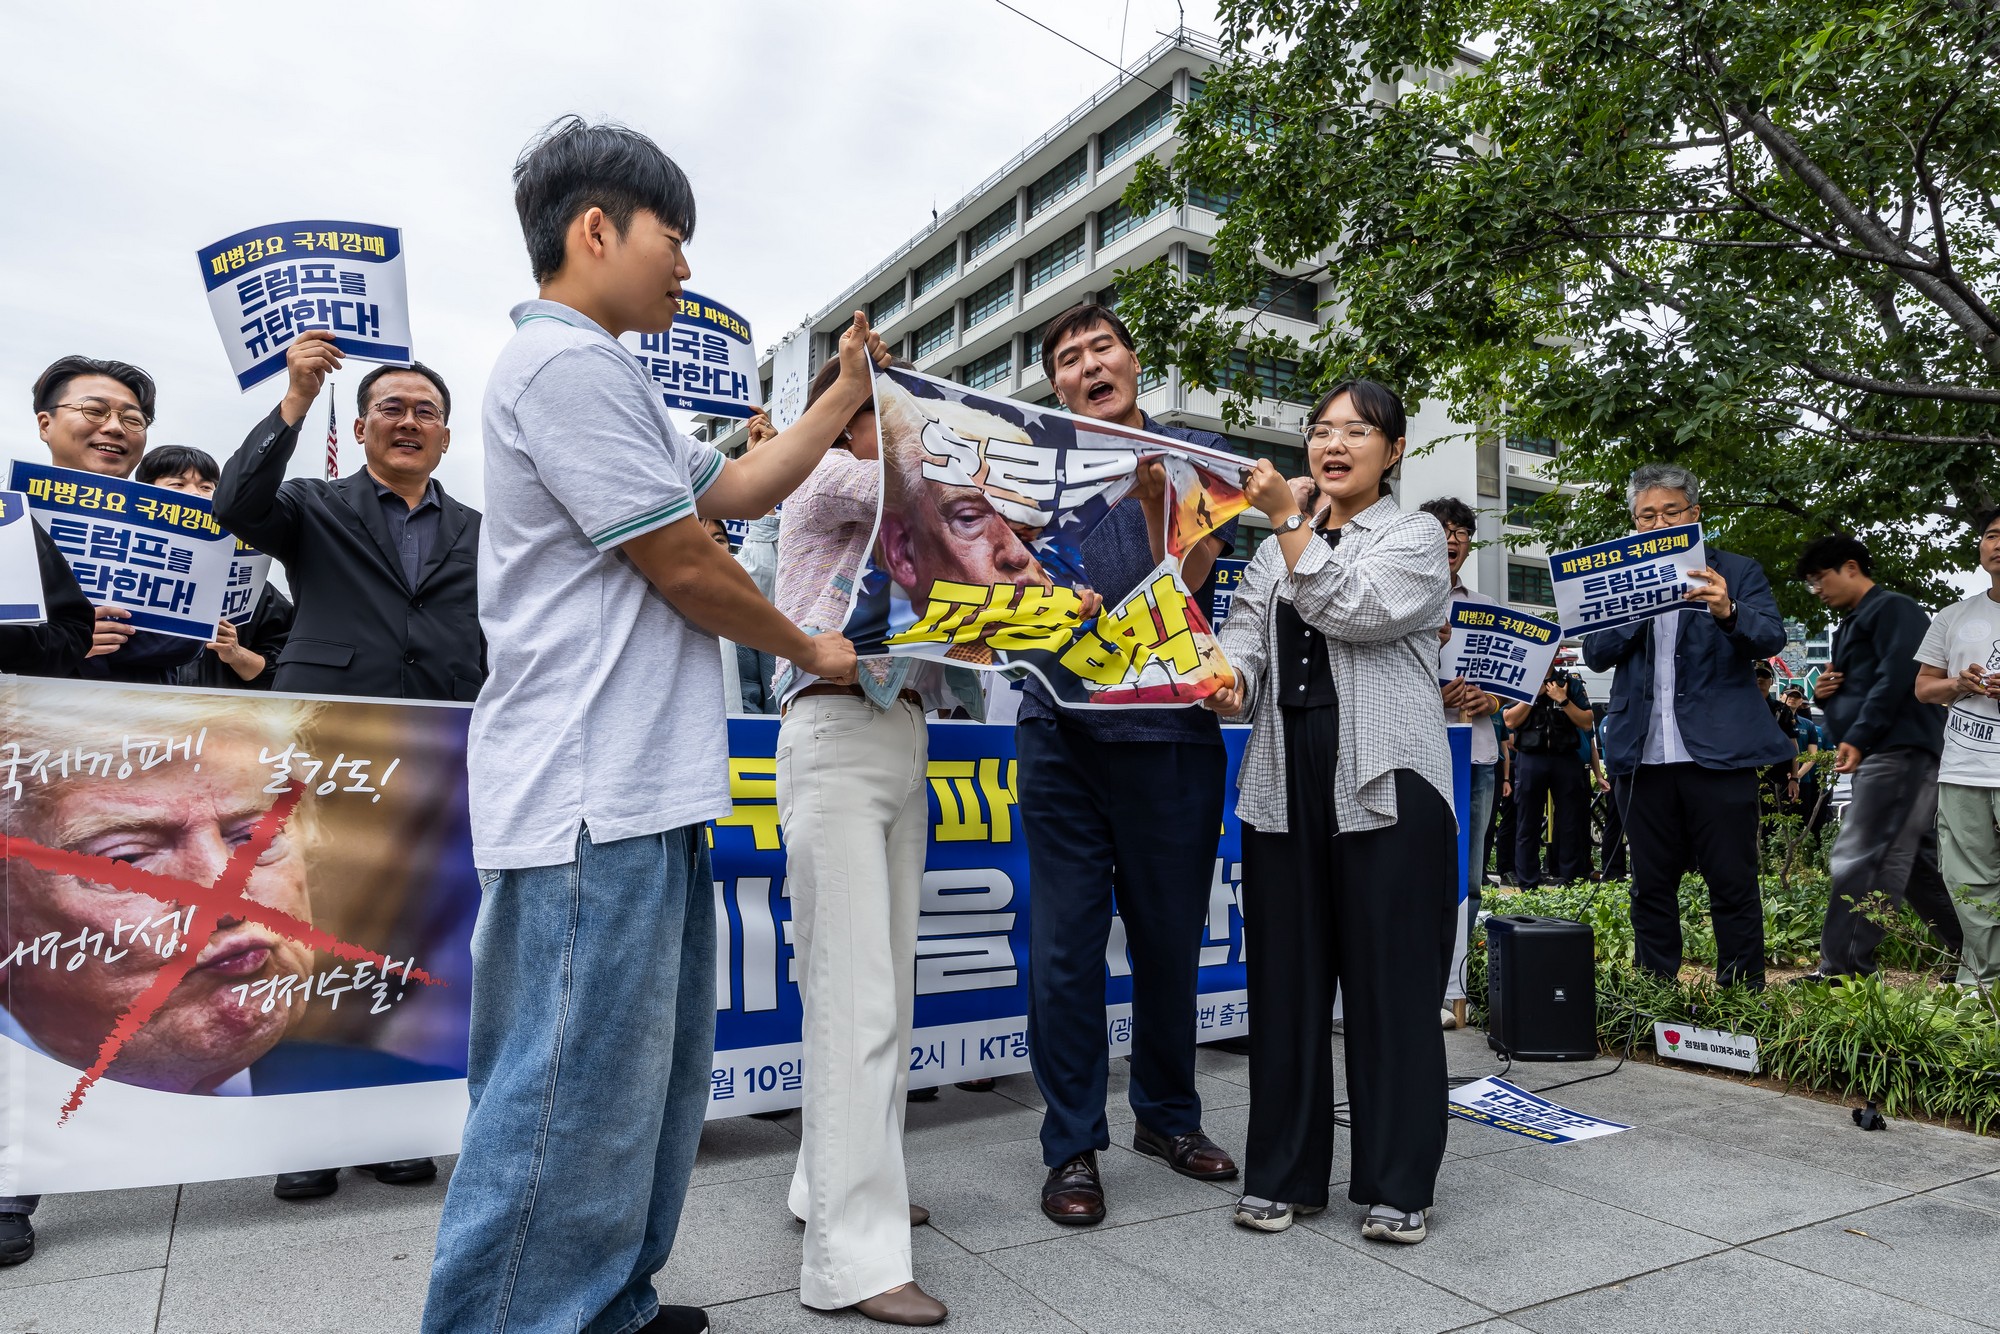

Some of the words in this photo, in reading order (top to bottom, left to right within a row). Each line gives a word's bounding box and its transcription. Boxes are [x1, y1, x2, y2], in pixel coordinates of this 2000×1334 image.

[211, 236, 287, 275] 파병강요
[292, 231, 386, 257] 국제깡패
[236, 263, 367, 317] 트럼프를
[240, 298, 380, 360] 규탄한다!
[704, 306, 750, 342] 파병강요
[640, 327, 730, 366] 미국을
[640, 357, 749, 401] 탄한다!
[27, 478, 127, 514] 파병강요
[50, 518, 194, 575] 트럼프를
[1561, 549, 1624, 574] 파병강요
[1627, 533, 1689, 559] 국제깡패
[70, 561, 197, 615] 탄한다!
[1579, 582, 1687, 622] 규탄한다!
[1583, 563, 1678, 600] 트럼프를
[1457, 610, 1496, 626] 파병강요
[1498, 615, 1551, 642] 국제깡패
[1463, 633, 1528, 663] 트럼프를
[1455, 657, 1527, 687] 규탄한다!
[1950, 714, 1962, 732] ALL
[1969, 721, 1994, 741] STAR
[0, 727, 207, 801] 국제깡패!
[258, 742, 400, 803] 날강도!
[231, 955, 414, 1015] 경제수탈!
[711, 1067, 734, 1100] 월
[744, 1059, 802, 1093] 10일
[980, 1030, 1028, 1061] KT광
[1197, 1005, 1216, 1029] 번
[1684, 1040, 1709, 1052] 정원을
[1710, 1044, 1750, 1059] 아껴주세요
